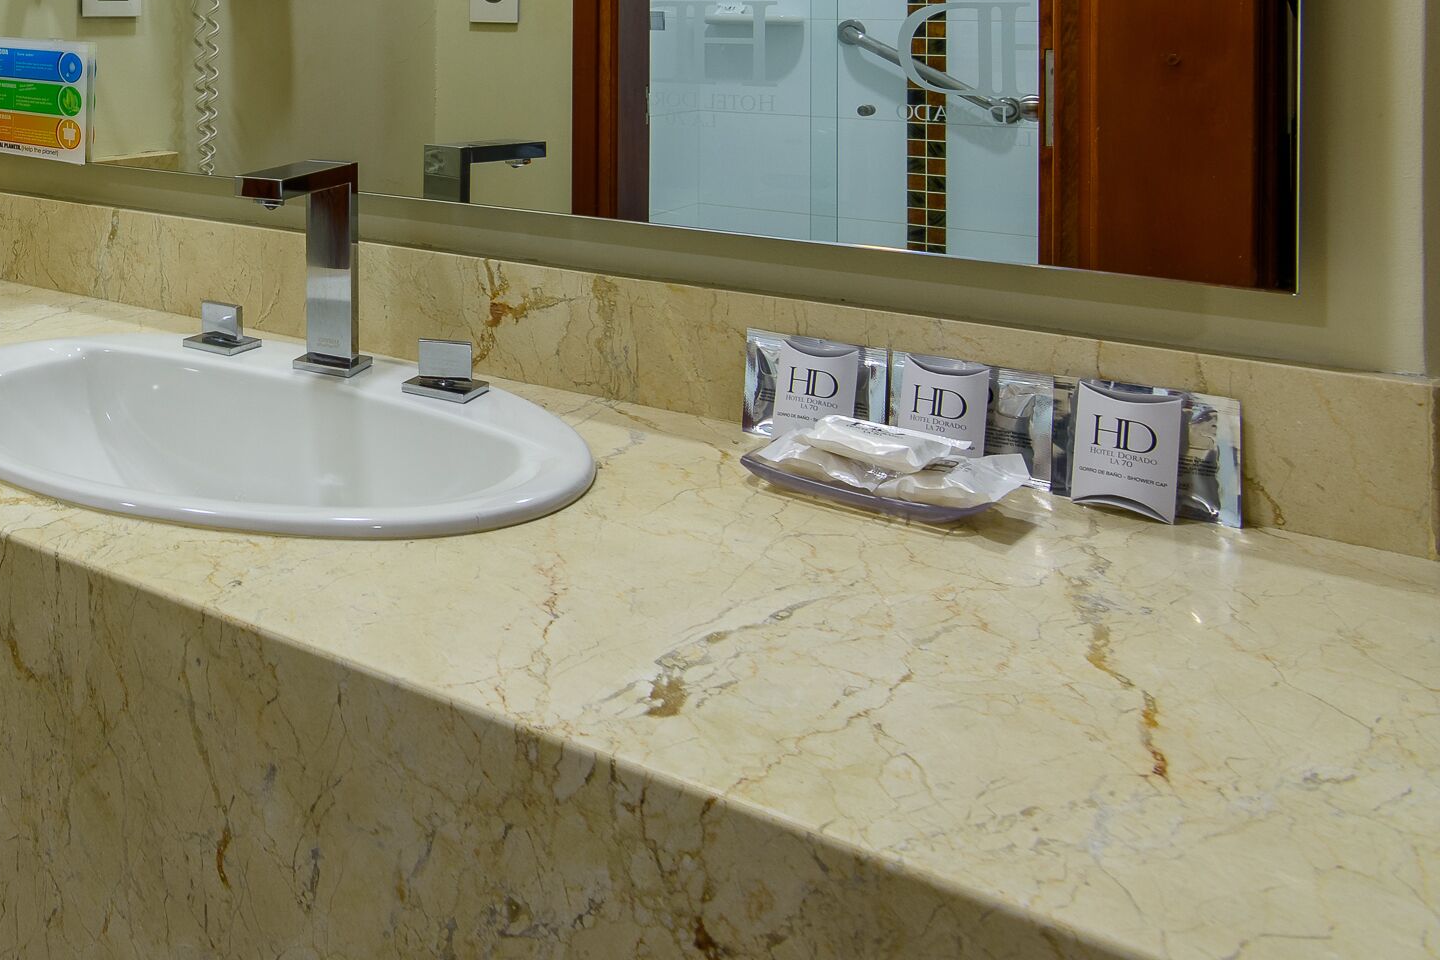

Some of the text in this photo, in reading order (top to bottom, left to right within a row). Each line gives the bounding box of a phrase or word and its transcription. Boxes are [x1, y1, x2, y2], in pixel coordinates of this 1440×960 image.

[787, 366, 839, 399] HD
[785, 394, 804, 403] HOTEL
[806, 395, 838, 409] DORADO
[809, 404, 819, 412] 70
[912, 384, 967, 420] HD
[910, 414, 967, 431] HOTEL DORADO
[935, 425, 945, 433] 70
[1091, 413, 1157, 454] HD
[1090, 446, 1158, 466] HOTEL DORADO
[1110, 458, 1133, 468] LA 70
[1079, 465, 1097, 474] GORRO
[1106, 470, 1123, 479] BAÑO
[1127, 475, 1155, 486] SHOWER
